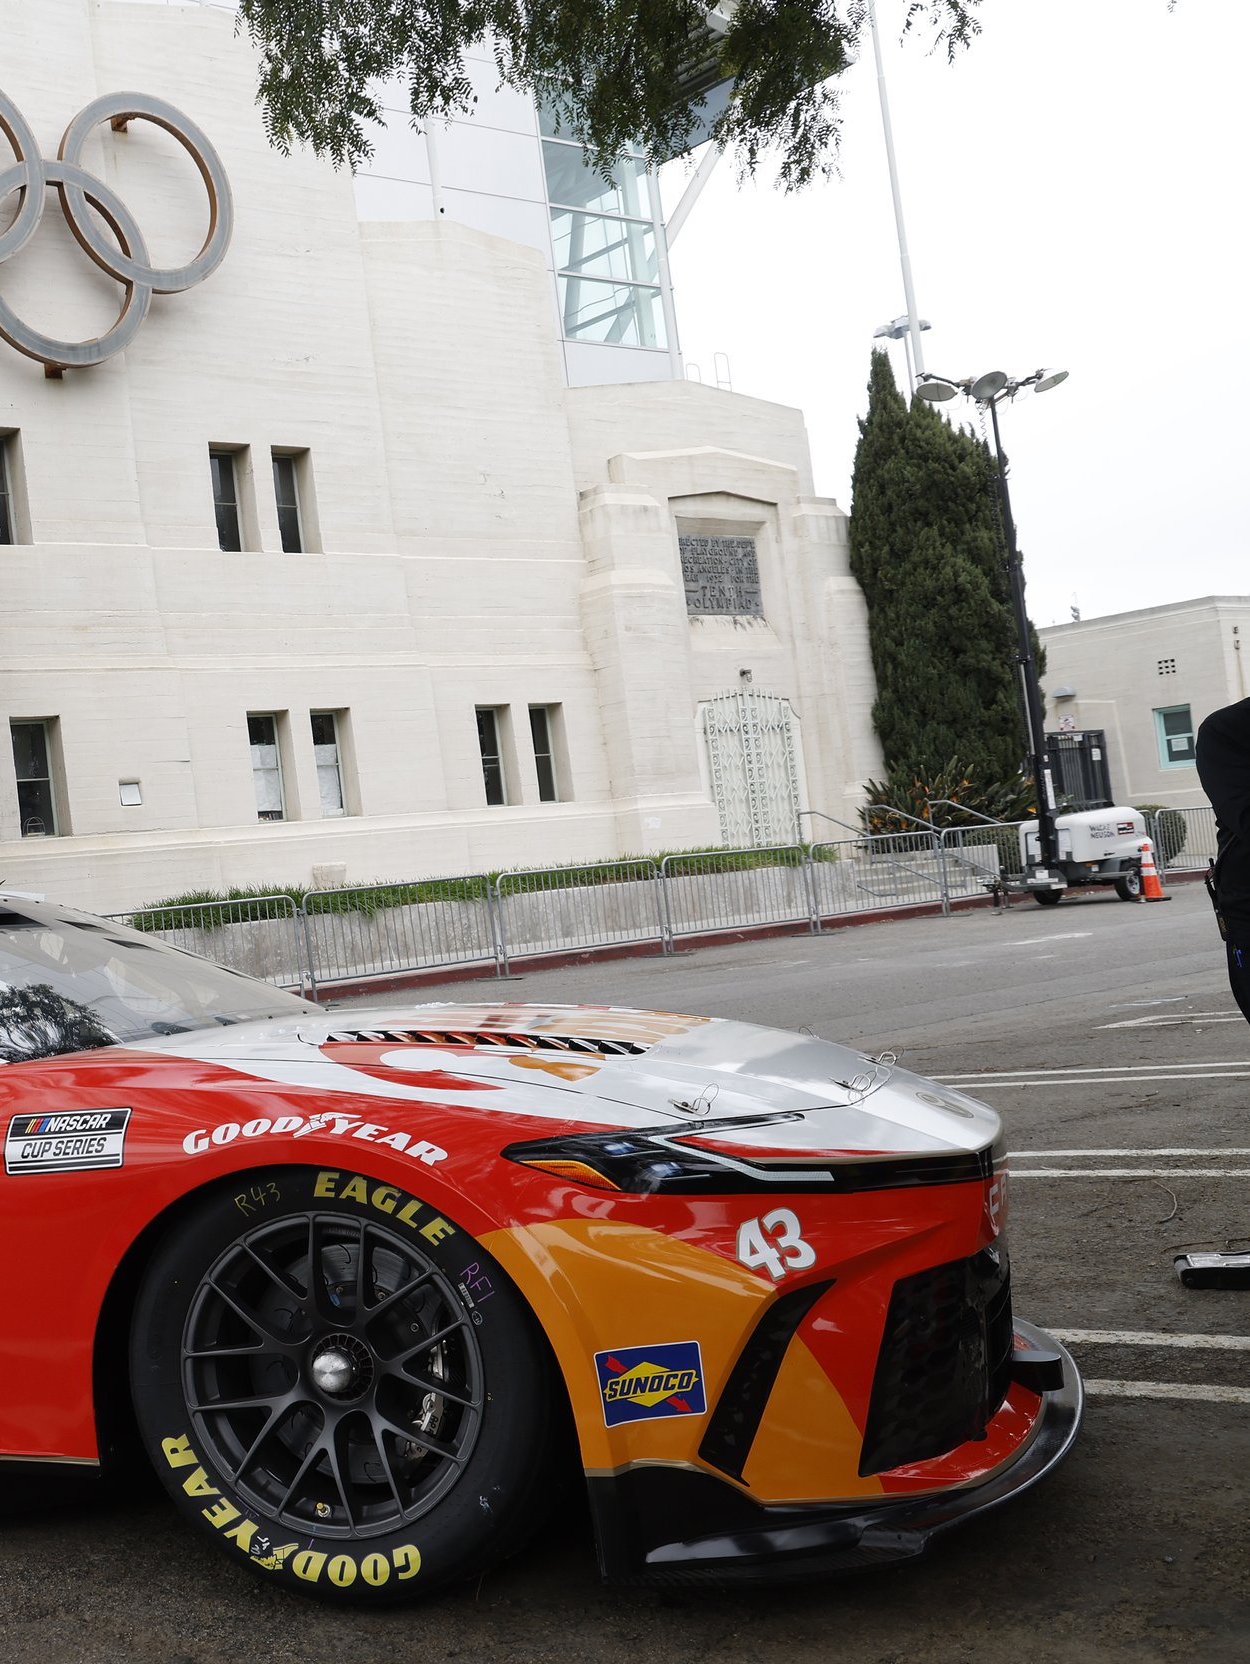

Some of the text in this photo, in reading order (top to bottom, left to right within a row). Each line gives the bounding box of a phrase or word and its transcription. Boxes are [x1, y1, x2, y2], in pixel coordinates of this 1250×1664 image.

[694, 597, 752, 609] OLYMPIAD
[701, 586, 743, 597] TENTH
[45, 1114, 111, 1132] NASCAR
[21, 1137, 107, 1159] CUP SERIES
[182, 1113, 448, 1167] GOODYEAR
[313, 1171, 456, 1247] EAGLE
[736, 1207, 817, 1281] 43
[608, 1371, 695, 1400] SUNOCO
[161, 1433, 422, 1587] GOODYEAR
